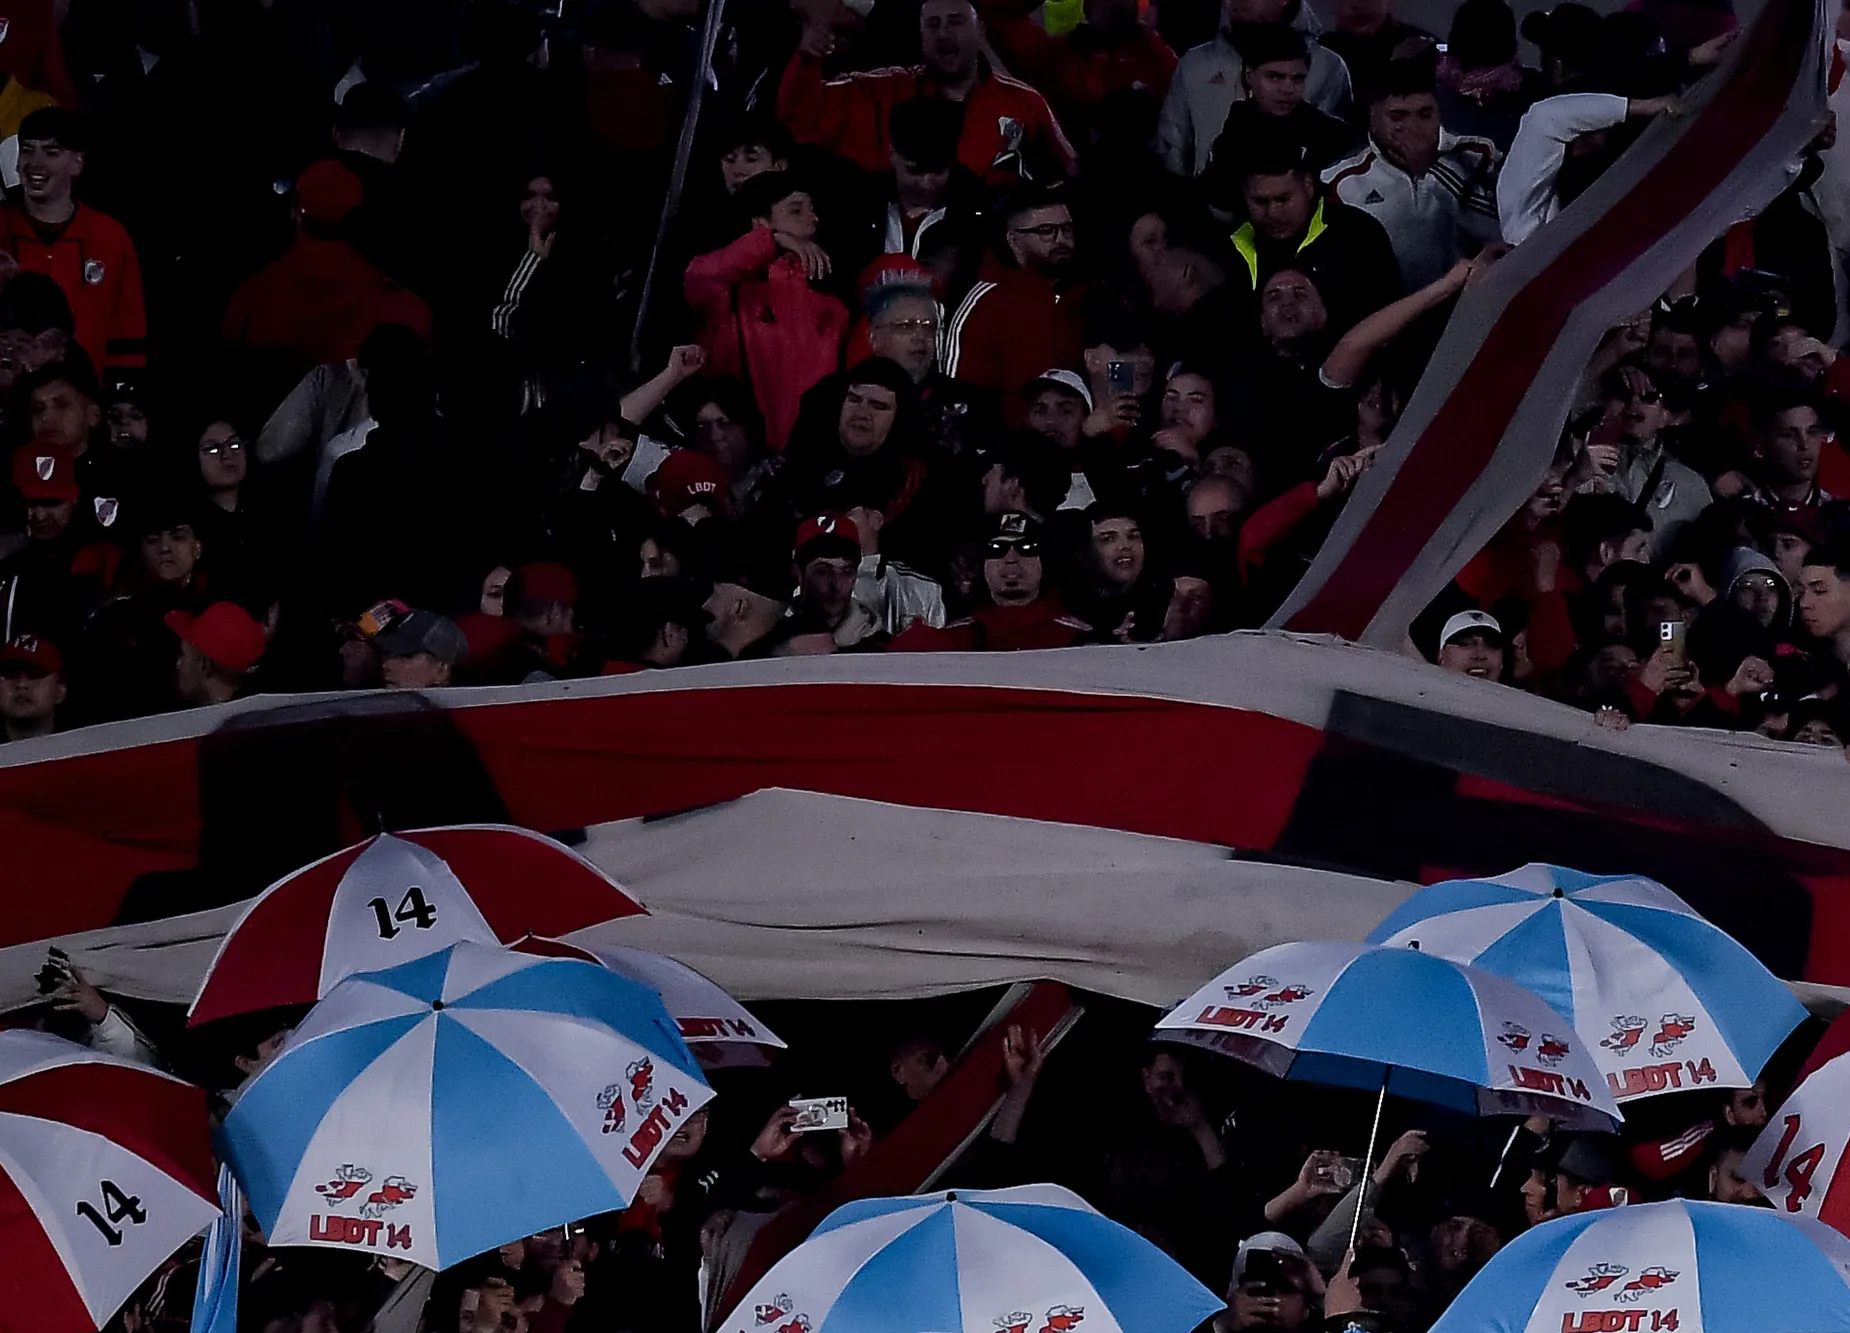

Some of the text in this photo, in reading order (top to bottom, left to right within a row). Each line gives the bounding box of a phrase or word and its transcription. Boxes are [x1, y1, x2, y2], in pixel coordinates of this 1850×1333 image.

[687, 481, 717, 495] LBDT
[367, 886, 438, 940] 14
[1195, 1005, 1289, 1033] LBDT 14
[1565, 1076, 1592, 1102] 14
[1605, 1056, 1718, 1100] LBDT 14
[622, 1087, 688, 1171] LBDT 14
[1763, 1113, 1826, 1214] 14
[76, 1180, 148, 1246] 14
[309, 1214, 413, 1251] LBDT 14
[1649, 1309, 1680, 1333] 14
